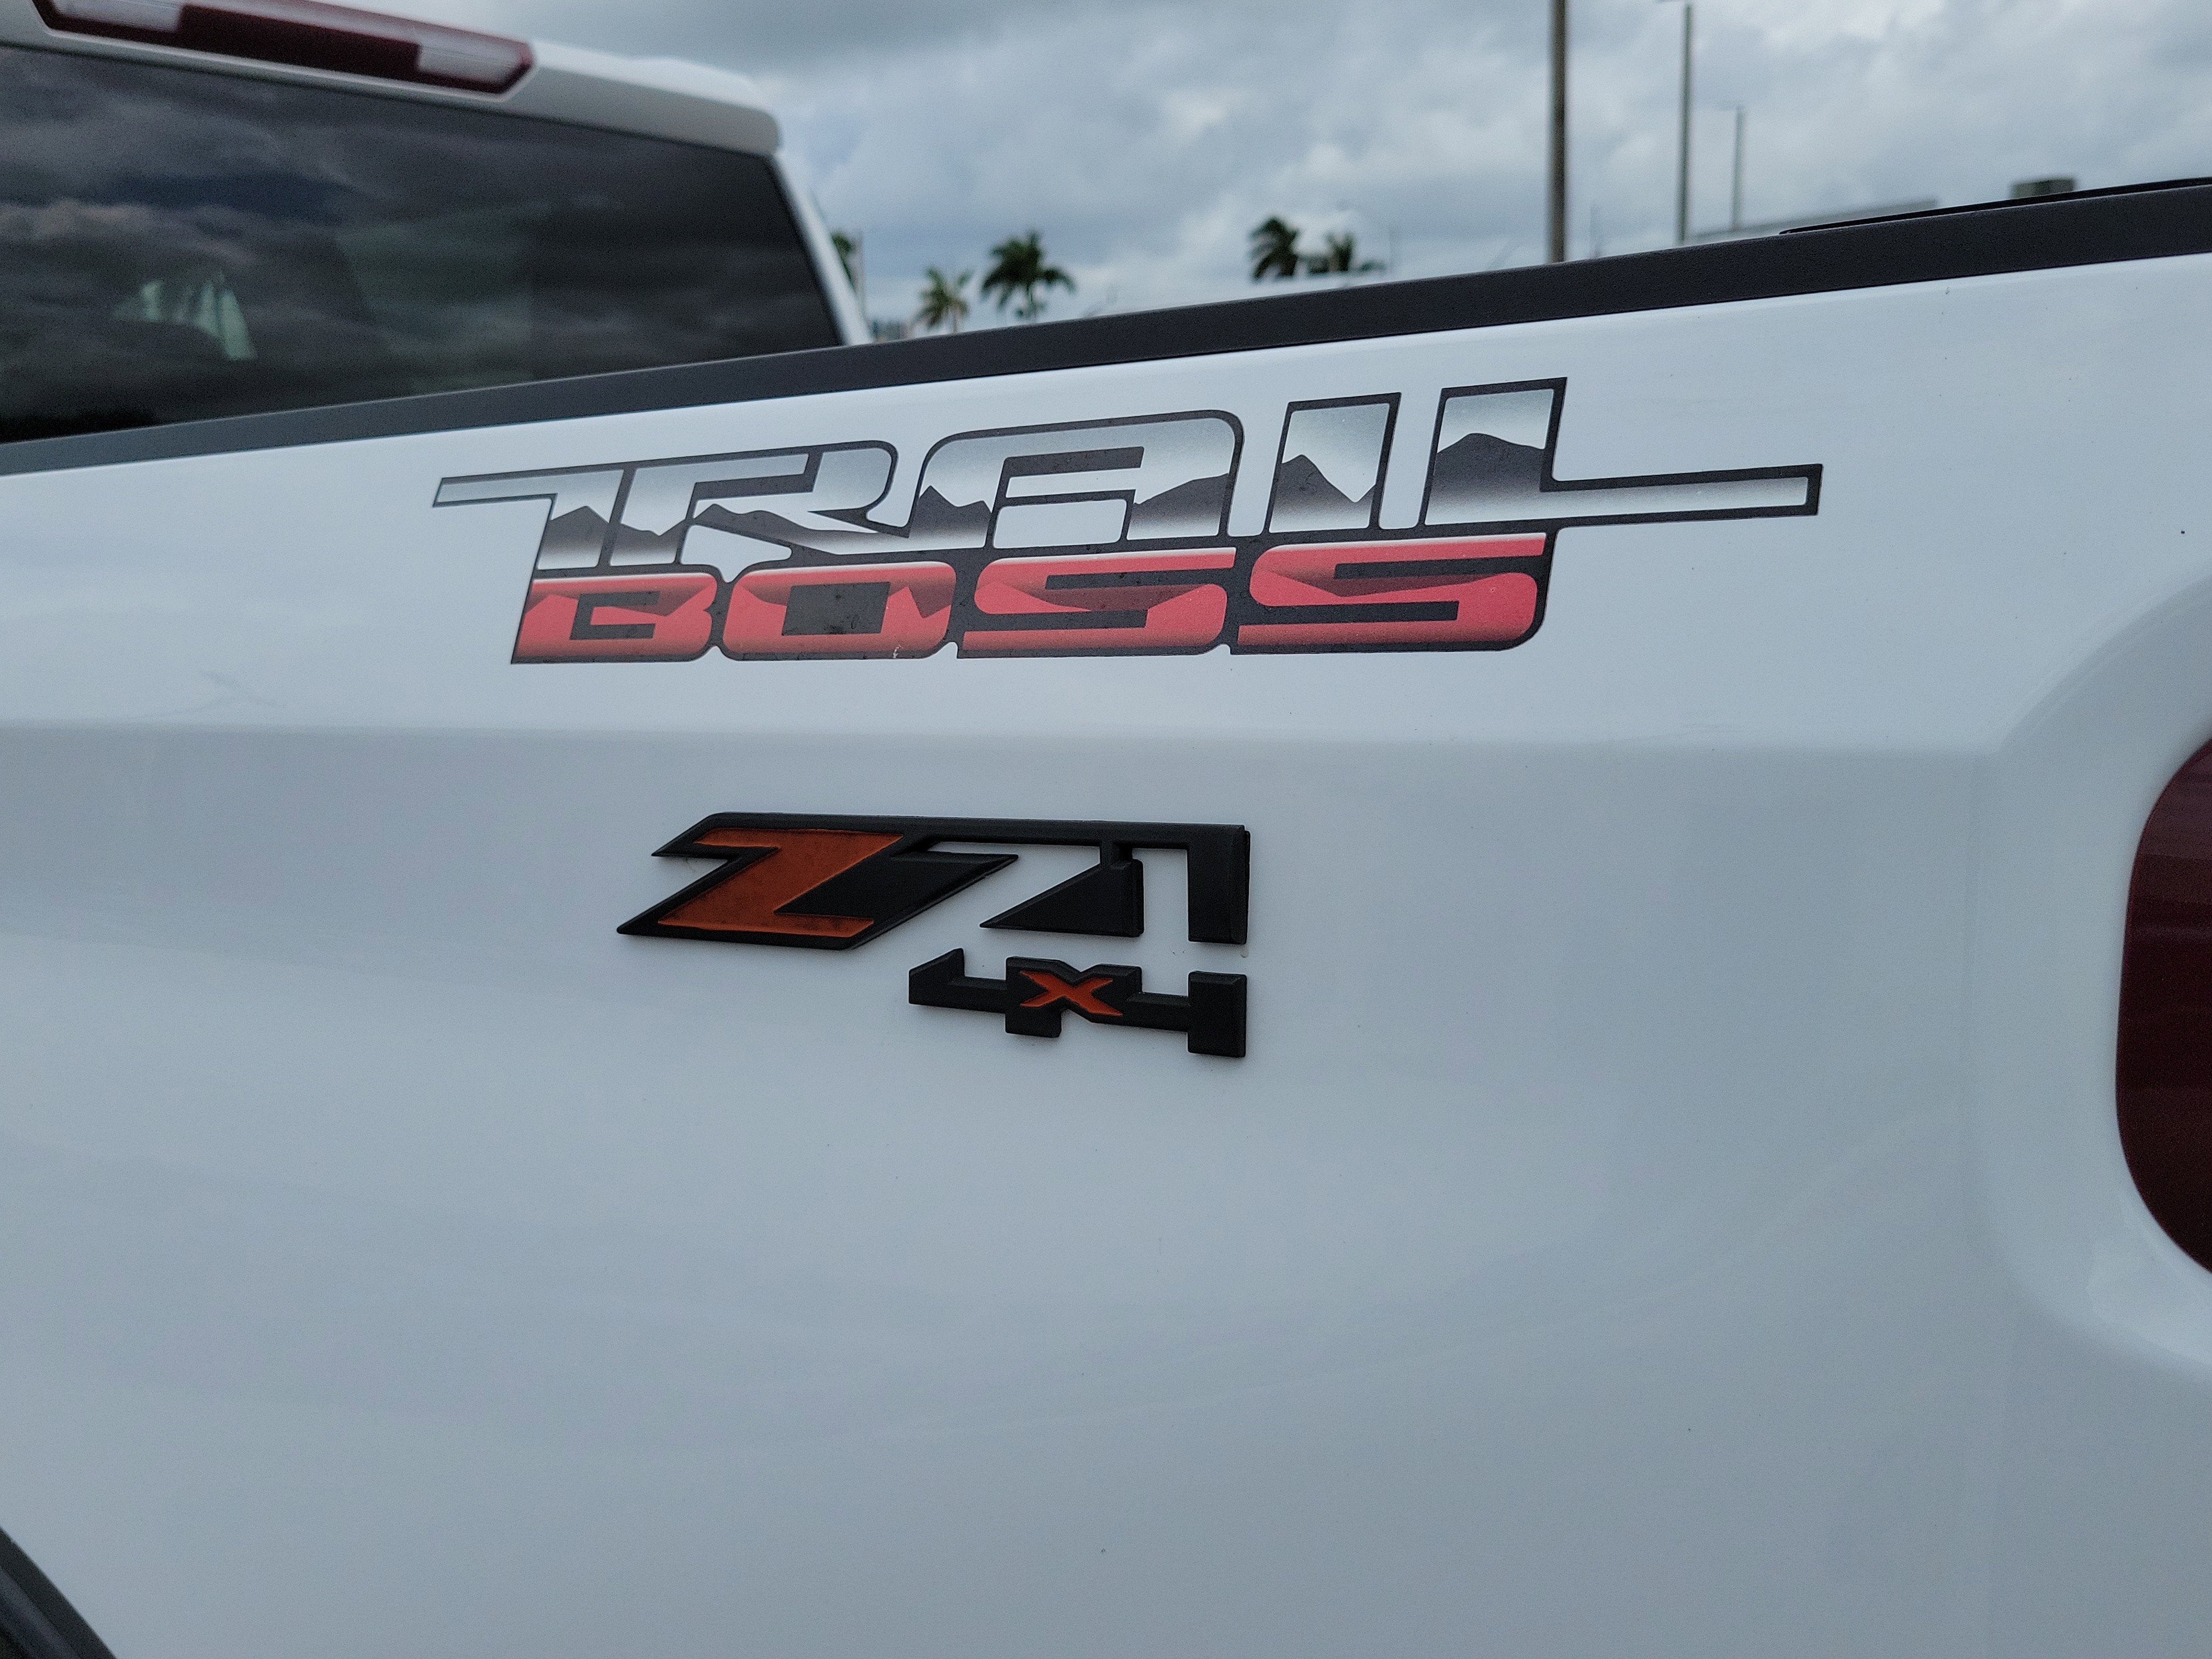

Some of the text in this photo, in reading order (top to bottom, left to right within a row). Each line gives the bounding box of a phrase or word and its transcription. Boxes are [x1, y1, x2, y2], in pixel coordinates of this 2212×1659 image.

[433, 377, 1823, 571] TRAIL
[511, 529, 1556, 665] BOSS
[617, 811, 1250, 950] Z71
